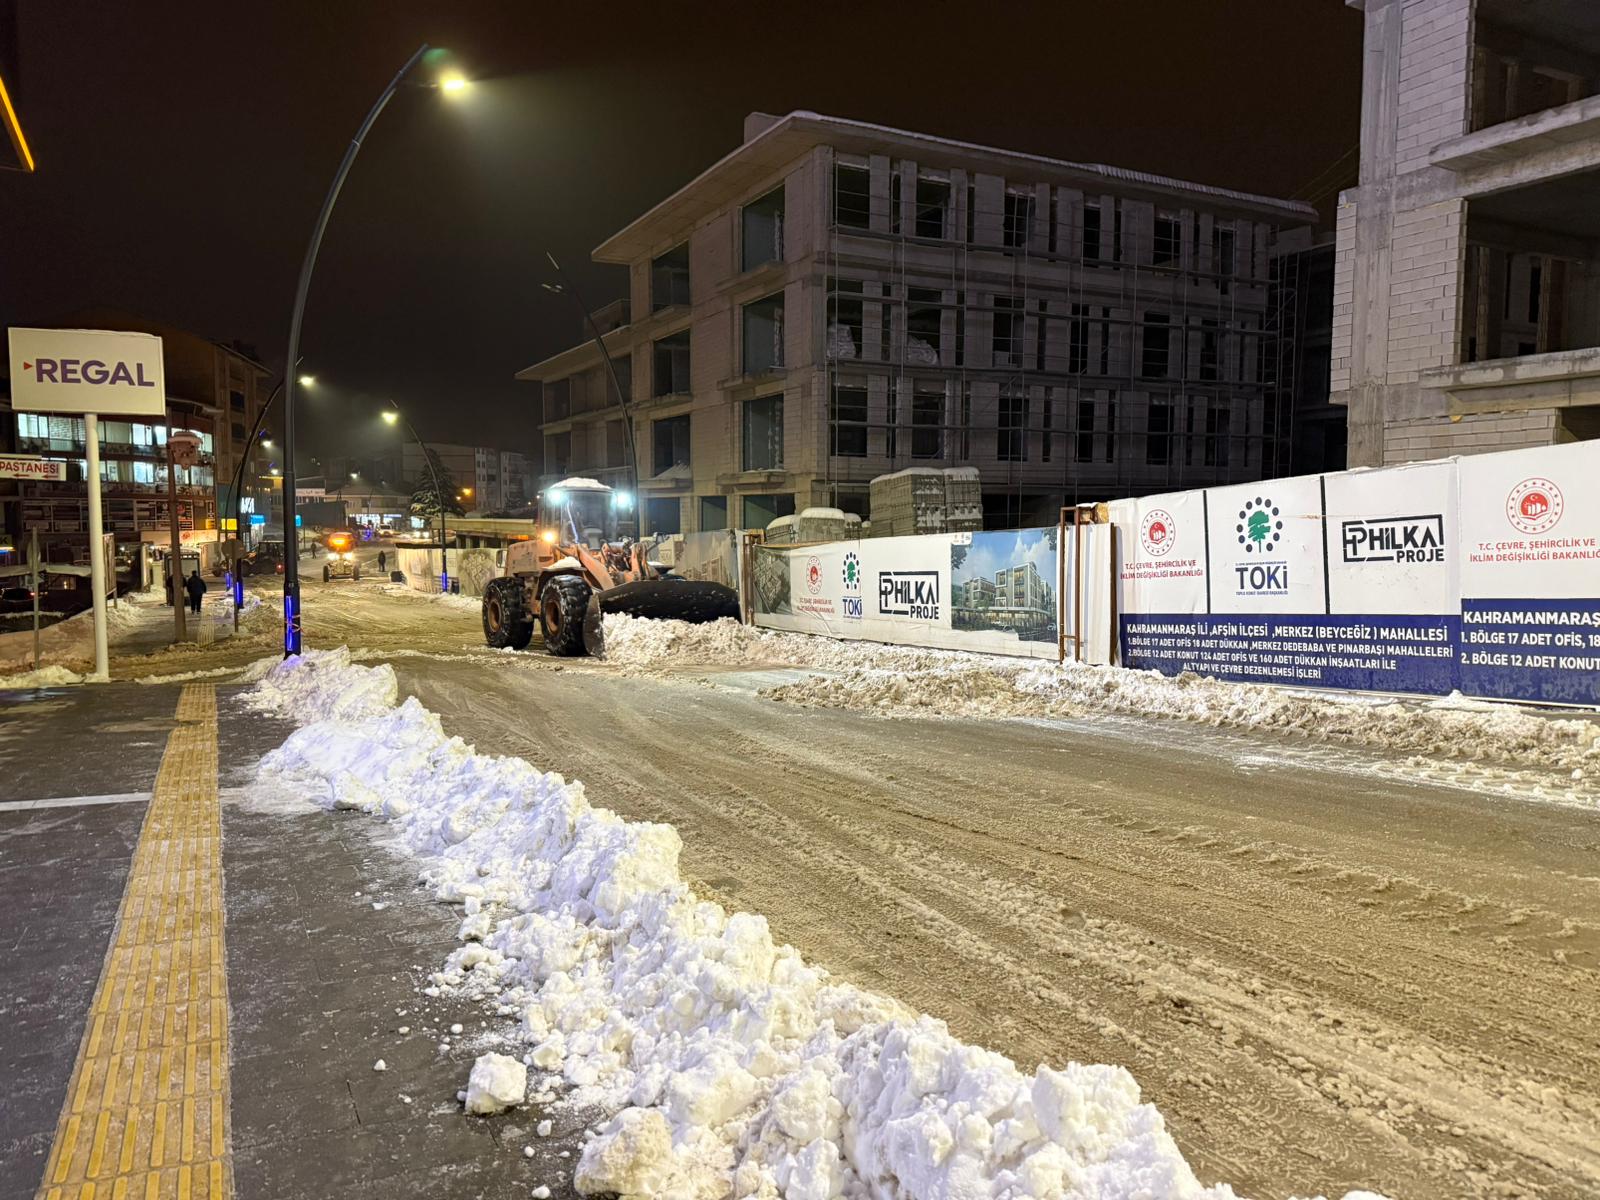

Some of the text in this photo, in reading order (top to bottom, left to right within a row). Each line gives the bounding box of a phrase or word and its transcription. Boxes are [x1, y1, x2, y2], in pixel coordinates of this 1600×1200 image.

[35, 358, 155, 387] REGAL
[1529, 538, 1581, 550] ŞEHİRCİLİK
[1583, 538, 1596, 546] VE
[1396, 548, 1444, 563] PROJE
[1470, 553, 1494, 562] İKLİM
[1496, 551, 1550, 562] DEĞİŞİKLİĞİ
[910, 605, 940, 620] PROJE
[1127, 624, 1196, 635] KAHRAMANMARAŞ
[1197, 622, 1209, 634] İLİ
[1239, 623, 1268, 637] İLÇESİ
[1380, 626, 1448, 641] MAHALLESİ
[1461, 631, 1469, 643] 1.
[1470, 629, 1505, 643] BÖLGE
[1507, 632, 1519, 644] 17
[1521, 632, 1552, 645] ADET
[1554, 631, 1586, 648] OFİS,
[1159, 639, 1176, 647] ADET
[1177, 637, 1192, 647] OFİS
[1201, 639, 1218, 649] ADET
[1219, 638, 1249, 650] DÜKKAN
[1282, 642, 1325, 653] DEDEBABA
[1326, 644, 1337, 653] VE
[1338, 644, 1385, 656] PINARBAŞI
[1387, 645, 1453, 658] MAHALLELERİ
[1152, 650, 1159, 658] 12
[1160, 651, 1176, 659] ADET
[1177, 651, 1199, 660] KONUT
[1212, 652, 1230, 662] ADET
[1231, 651, 1247, 662] OFİS
[1248, 654, 1258, 663] VE
[1260, 654, 1273, 663] 160
[1273, 654, 1293, 665] ADET
[1294, 655, 1328, 667] DÜKKAN
[1329, 655, 1380, 670] İNŞAATLARI
[1382, 657, 1397, 670] İLE
[1461, 650, 1600, 671] 2. BÖLGE 12 ADET KONUT
[1183, 662, 1321, 679] ALTYAPI VE ÇEVRE DEZENLEMESİ İŞLERİ
